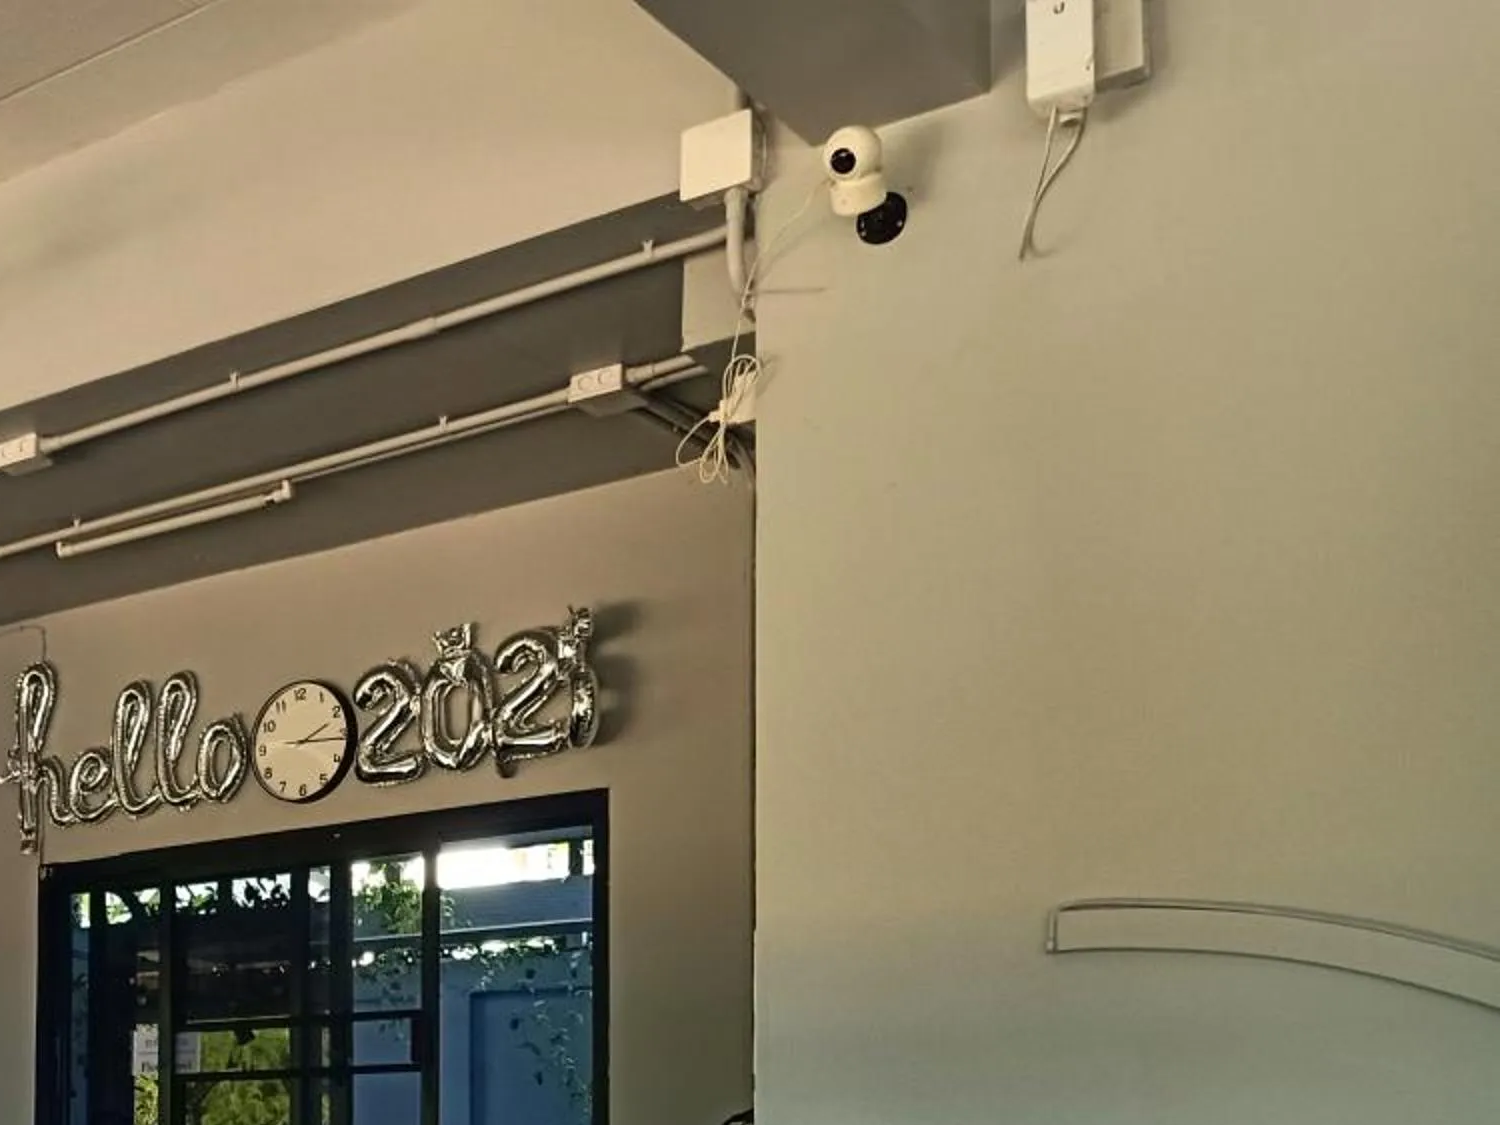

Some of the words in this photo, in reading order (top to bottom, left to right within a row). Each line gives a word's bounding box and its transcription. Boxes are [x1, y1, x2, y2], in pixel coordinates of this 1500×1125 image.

[293, 687, 307, 701] 12
[319, 691, 325, 703] 1
[354, 606, 599, 785] 2021
[275, 700, 287, 713] 11
[332, 705, 341, 718] 2
[263, 719, 277, 733] 10
[258, 745, 267, 757] 9
[333, 753, 341, 763] 4
[264, 767, 273, 779] 8
[319, 773, 328, 785] 5
[279, 781, 287, 792] 7
[299, 783, 307, 797] 6
